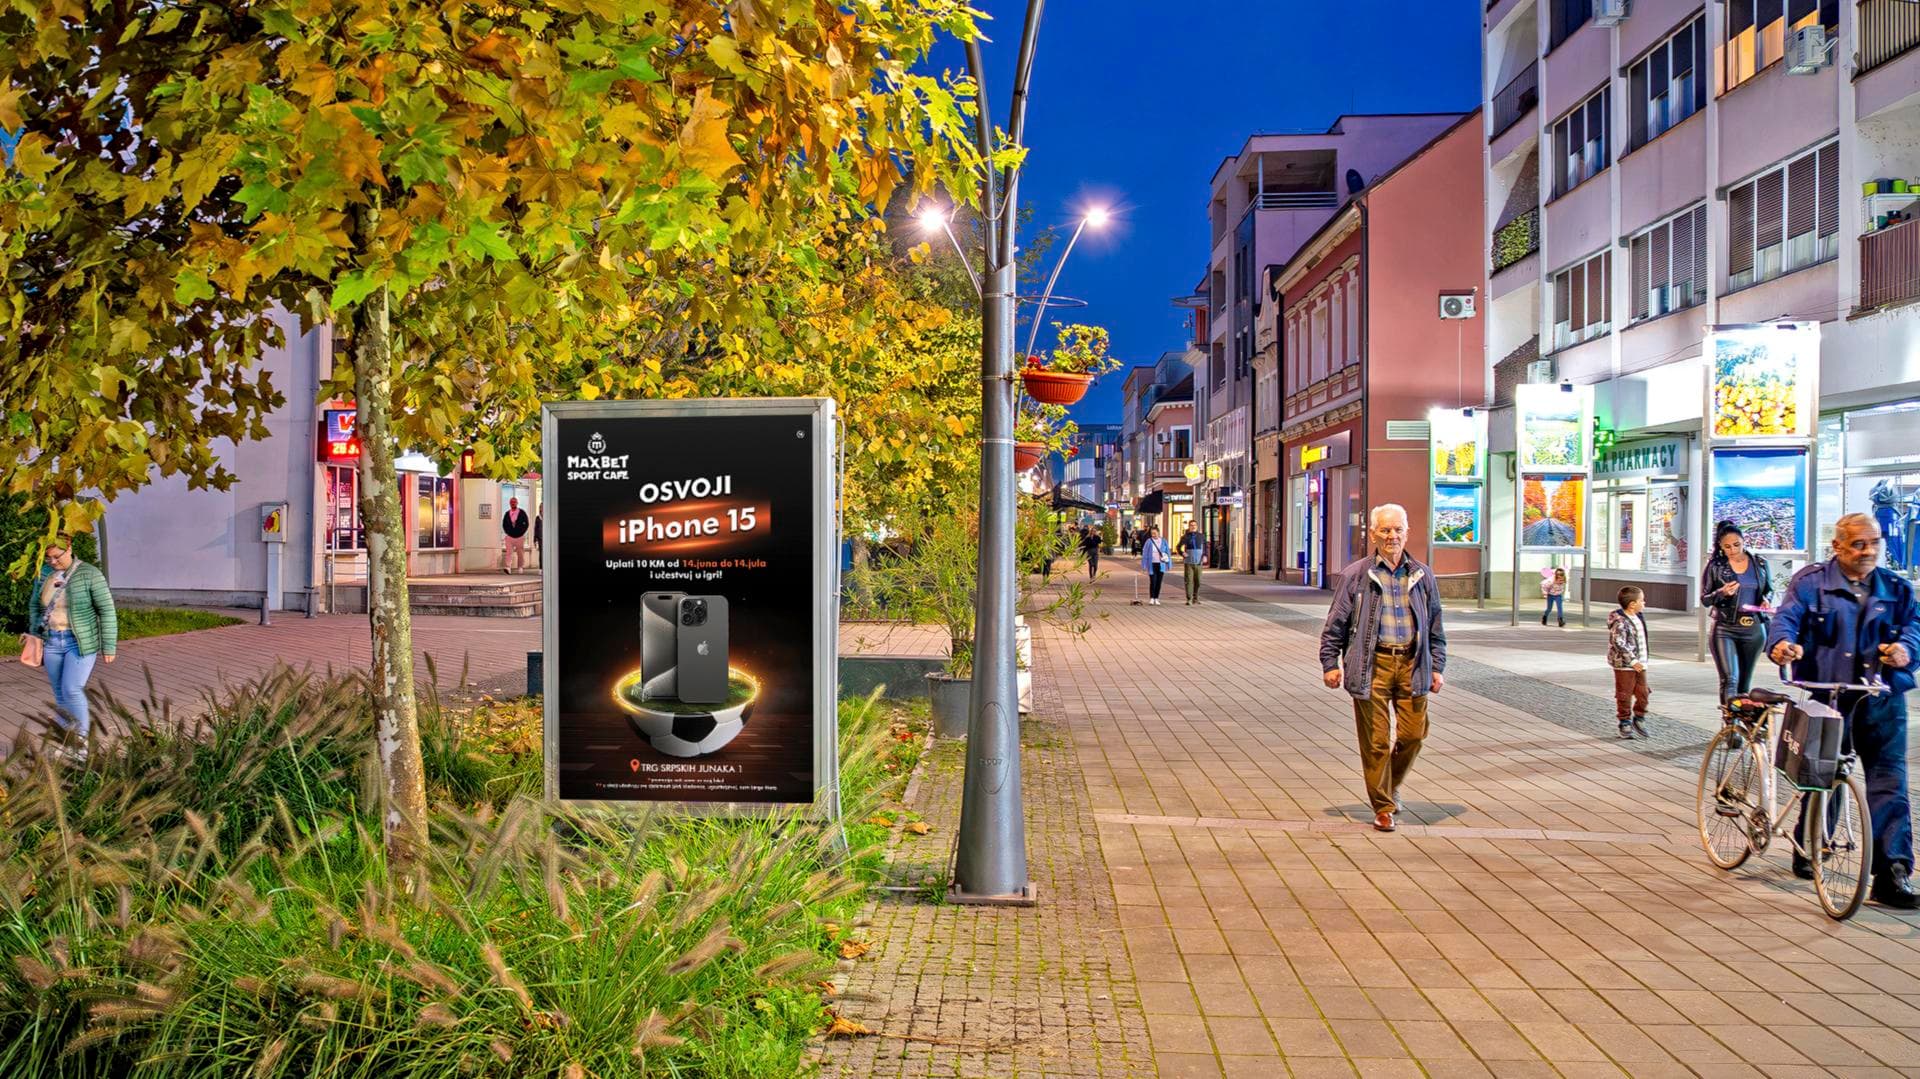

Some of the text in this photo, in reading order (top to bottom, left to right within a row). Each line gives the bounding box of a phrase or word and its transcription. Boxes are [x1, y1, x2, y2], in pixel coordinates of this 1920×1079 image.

[1611, 444, 1676, 472] PHARMACY
[567, 470, 630, 480] SPORT CAFE
[639, 475, 731, 503] OSVOJI
[619, 507, 756, 544] iPhone 15
[605, 559, 767, 570] Uplati 10 KM od 14.juna do 14.jula
[650, 570, 653, 579] i
[654, 570, 693, 581] učestvuj
[703, 570, 723, 581] igri!
[641, 763, 743, 773] TRG SRPSKIH JUNAKA 1
